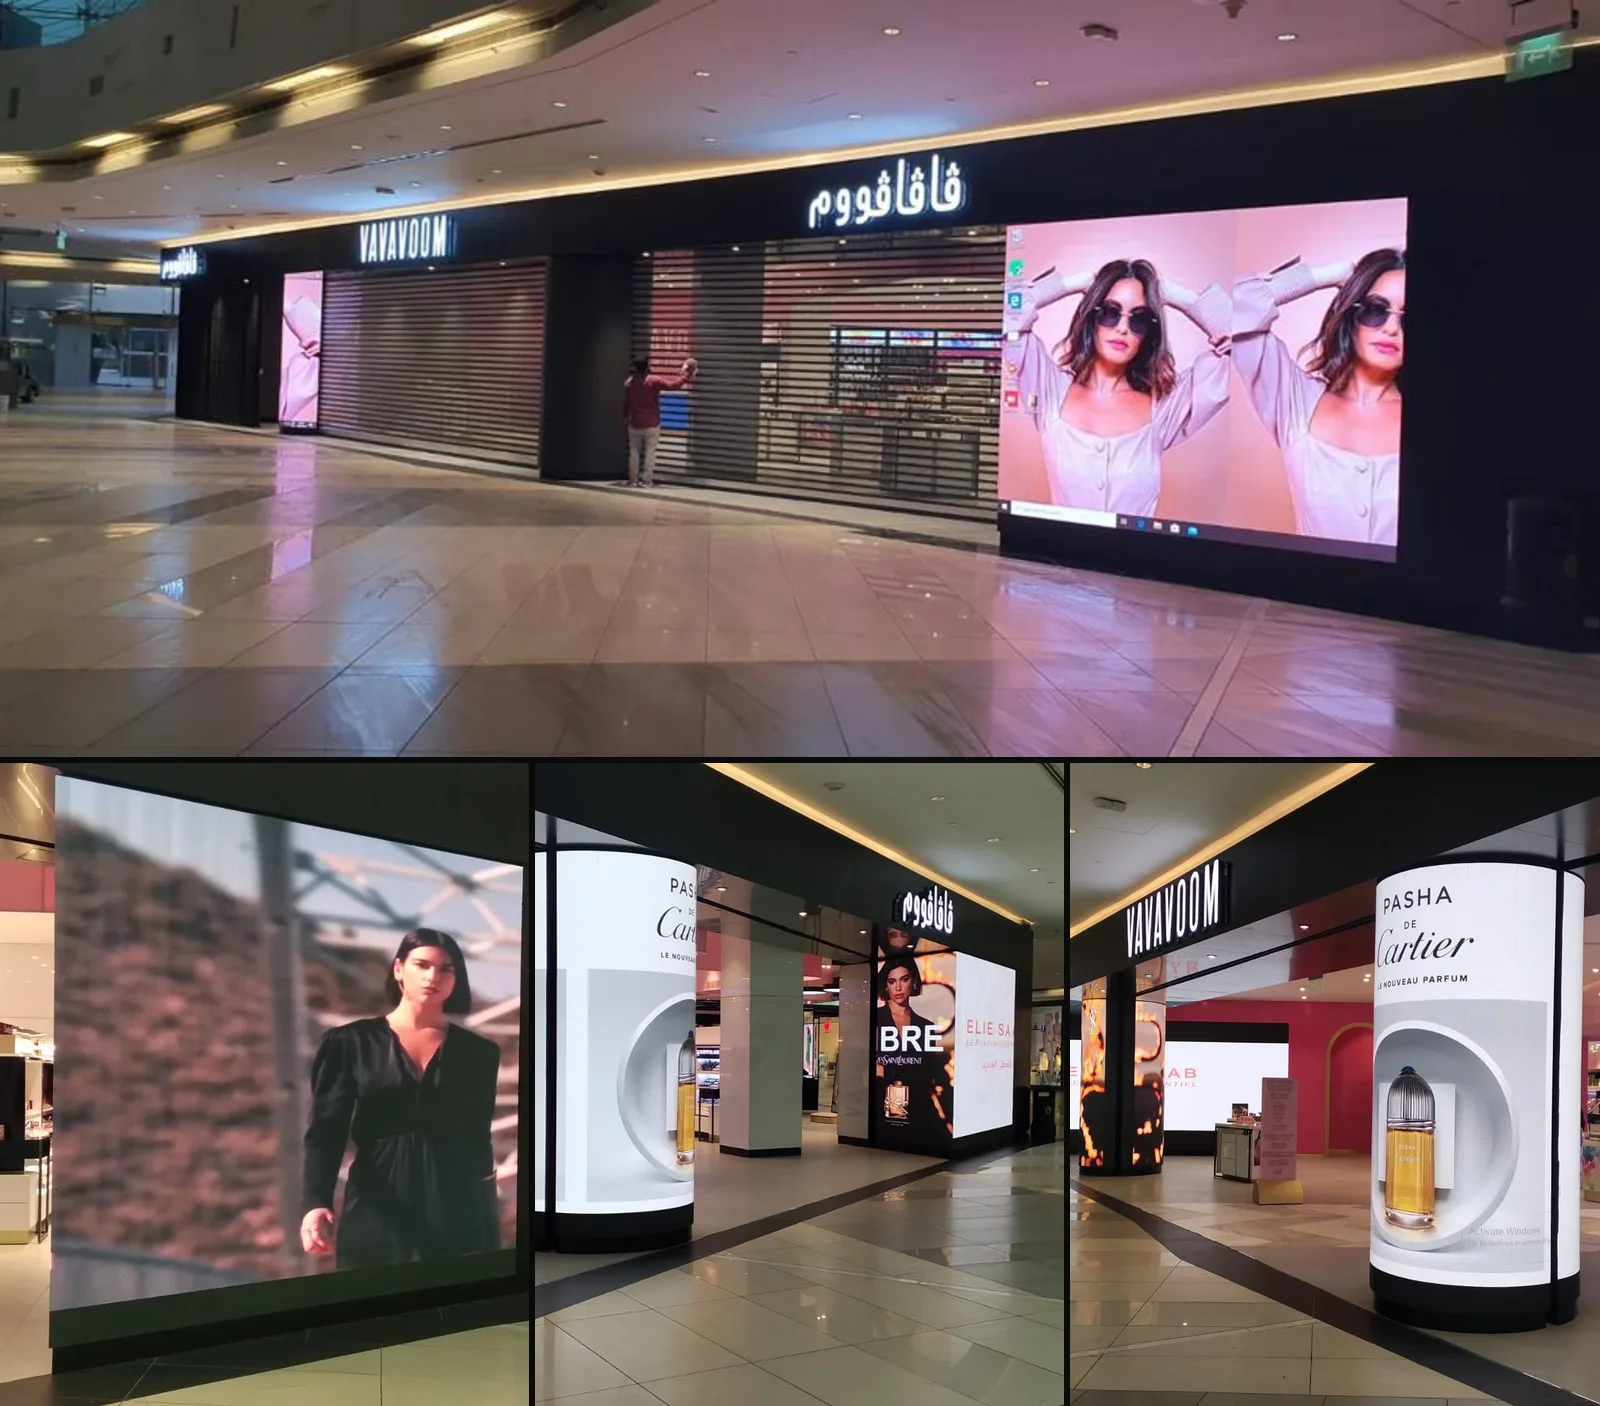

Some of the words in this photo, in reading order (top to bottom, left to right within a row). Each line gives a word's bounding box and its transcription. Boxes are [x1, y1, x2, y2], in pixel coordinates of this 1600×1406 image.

[359, 215, 447, 263] VAVAVOOM
[670, 877, 697, 898] PAS
[1126, 859, 1219, 958] VAVAVOOM
[1383, 886, 1453, 915] PASHA
[1403, 919, 1417, 930] DE
[660, 951, 669, 959] LE
[1377, 928, 1475, 968] Cartier
[1383, 977, 1419, 988] NOUVEAU
[1422, 974, 1468, 984] PARFUM
[966, 1019, 994, 1036] ELIE
[998, 1023, 1015, 1037] SA
[876, 1024, 944, 1052] BRE
[1167, 1068, 1197, 1078] AB
[1469, 1227, 1504, 1236] Activate
